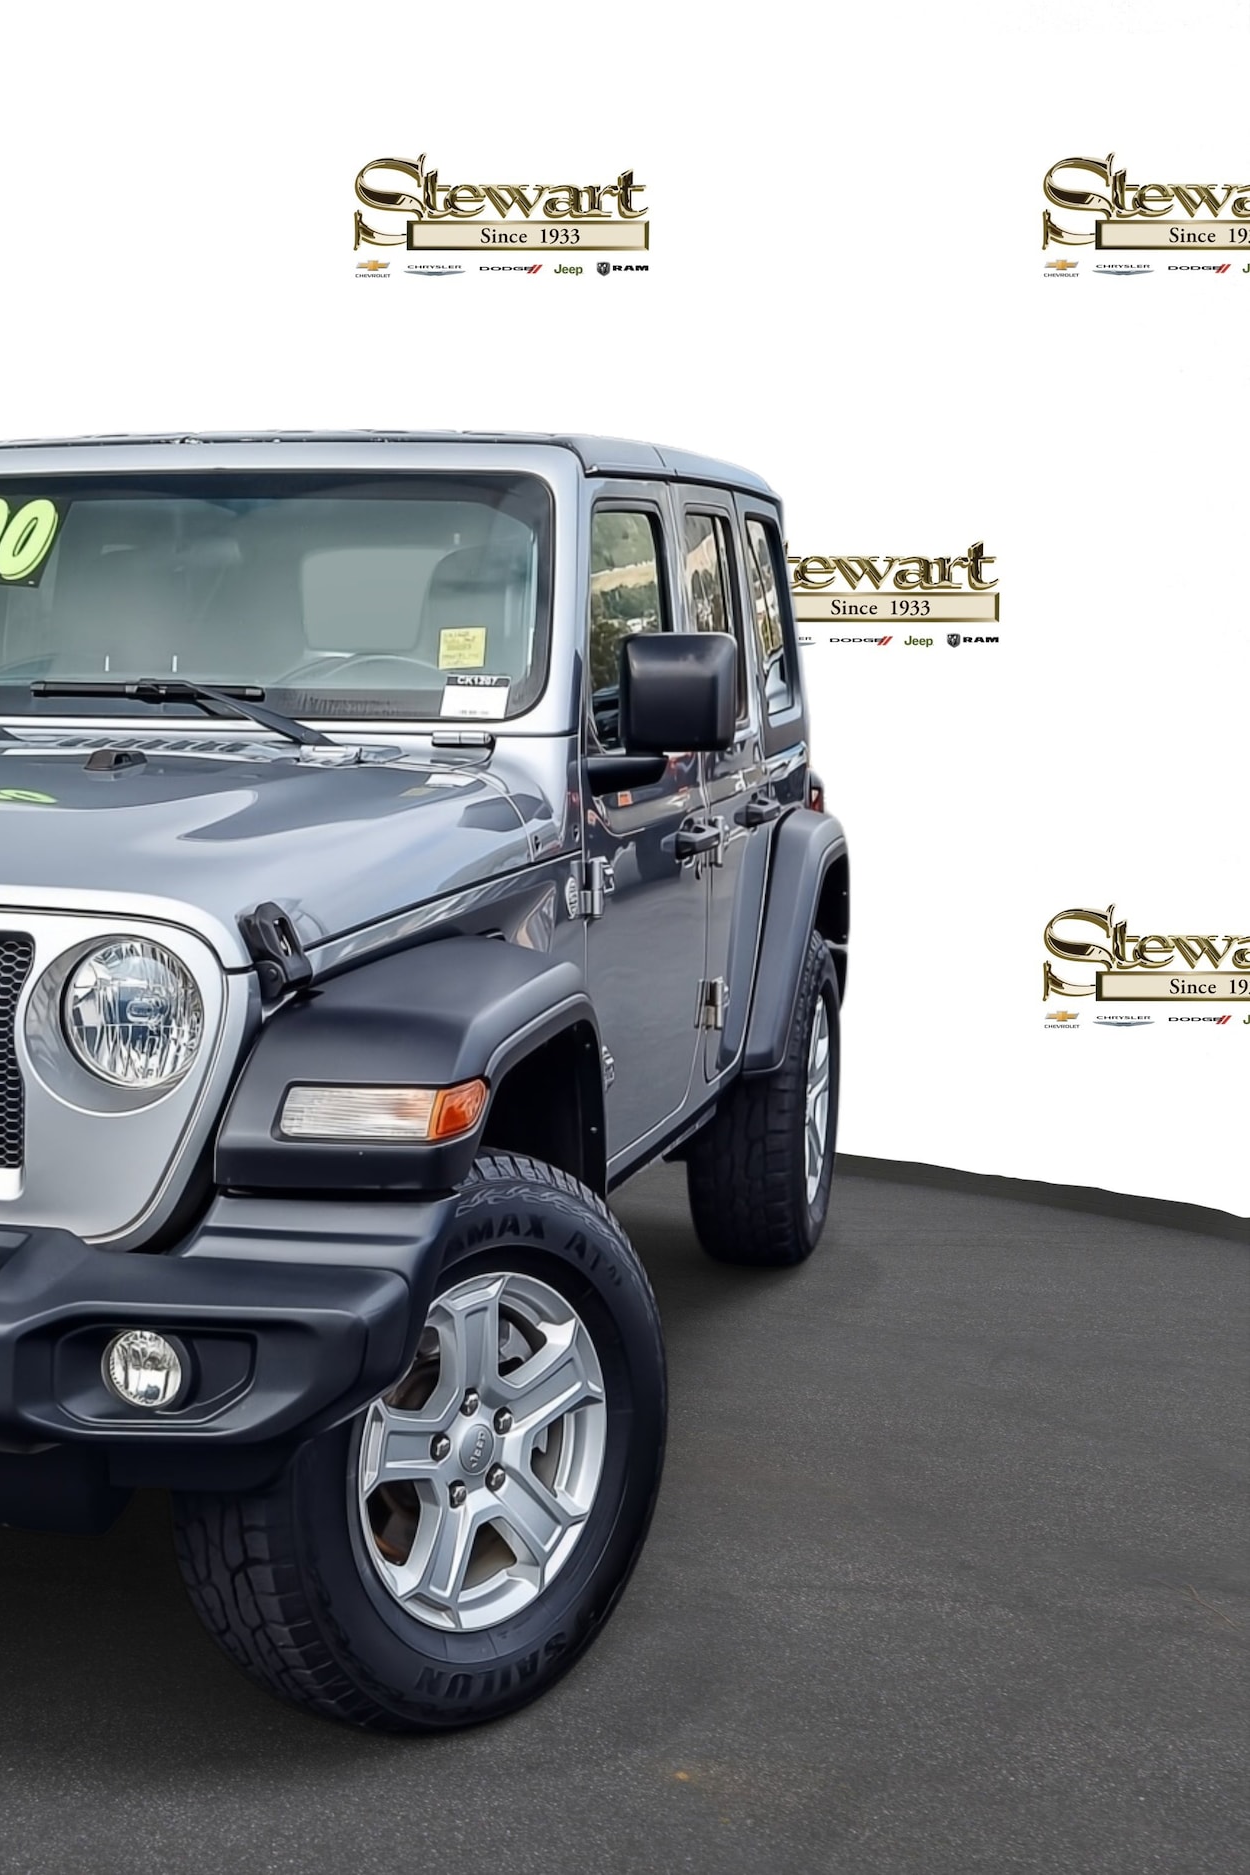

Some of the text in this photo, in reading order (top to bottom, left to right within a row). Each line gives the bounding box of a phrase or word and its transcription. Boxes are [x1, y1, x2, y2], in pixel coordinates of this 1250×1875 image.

[354, 152, 650, 250] Stewart
[480, 227, 581, 245] Since 1933
[1168, 227, 1250, 245] Since 19
[554, 263, 583, 275] Jeep
[830, 599, 931, 617] Since 1933
[904, 635, 933, 647] Jeep
[1169, 978, 1250, 996] Since 19
[415, 1632, 567, 1699] SAILUN
